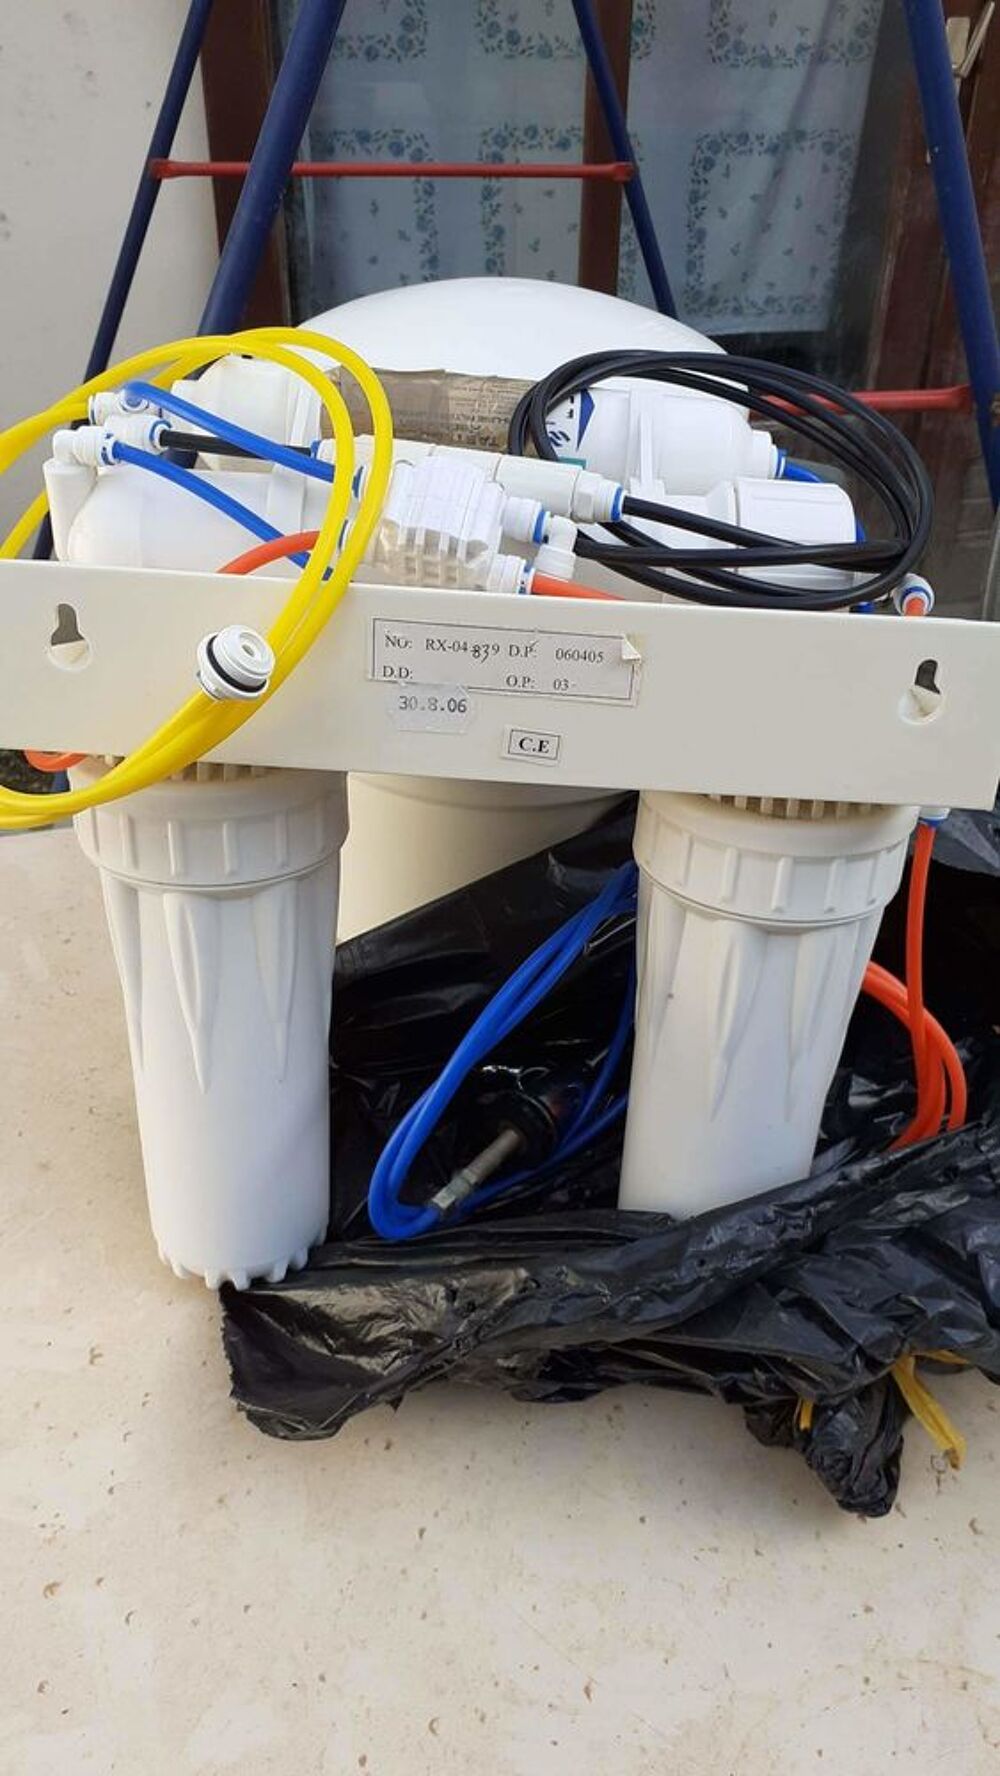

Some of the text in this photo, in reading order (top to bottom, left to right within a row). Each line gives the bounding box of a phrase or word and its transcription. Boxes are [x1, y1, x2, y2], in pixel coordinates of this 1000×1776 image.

[555, 648, 604, 663] 060405
[382, 665, 413, 680] D.D:
[505, 674, 536, 689] O.P:
[398, 695, 467, 713] 30.8.06
[518, 736, 550, 754] C.E
